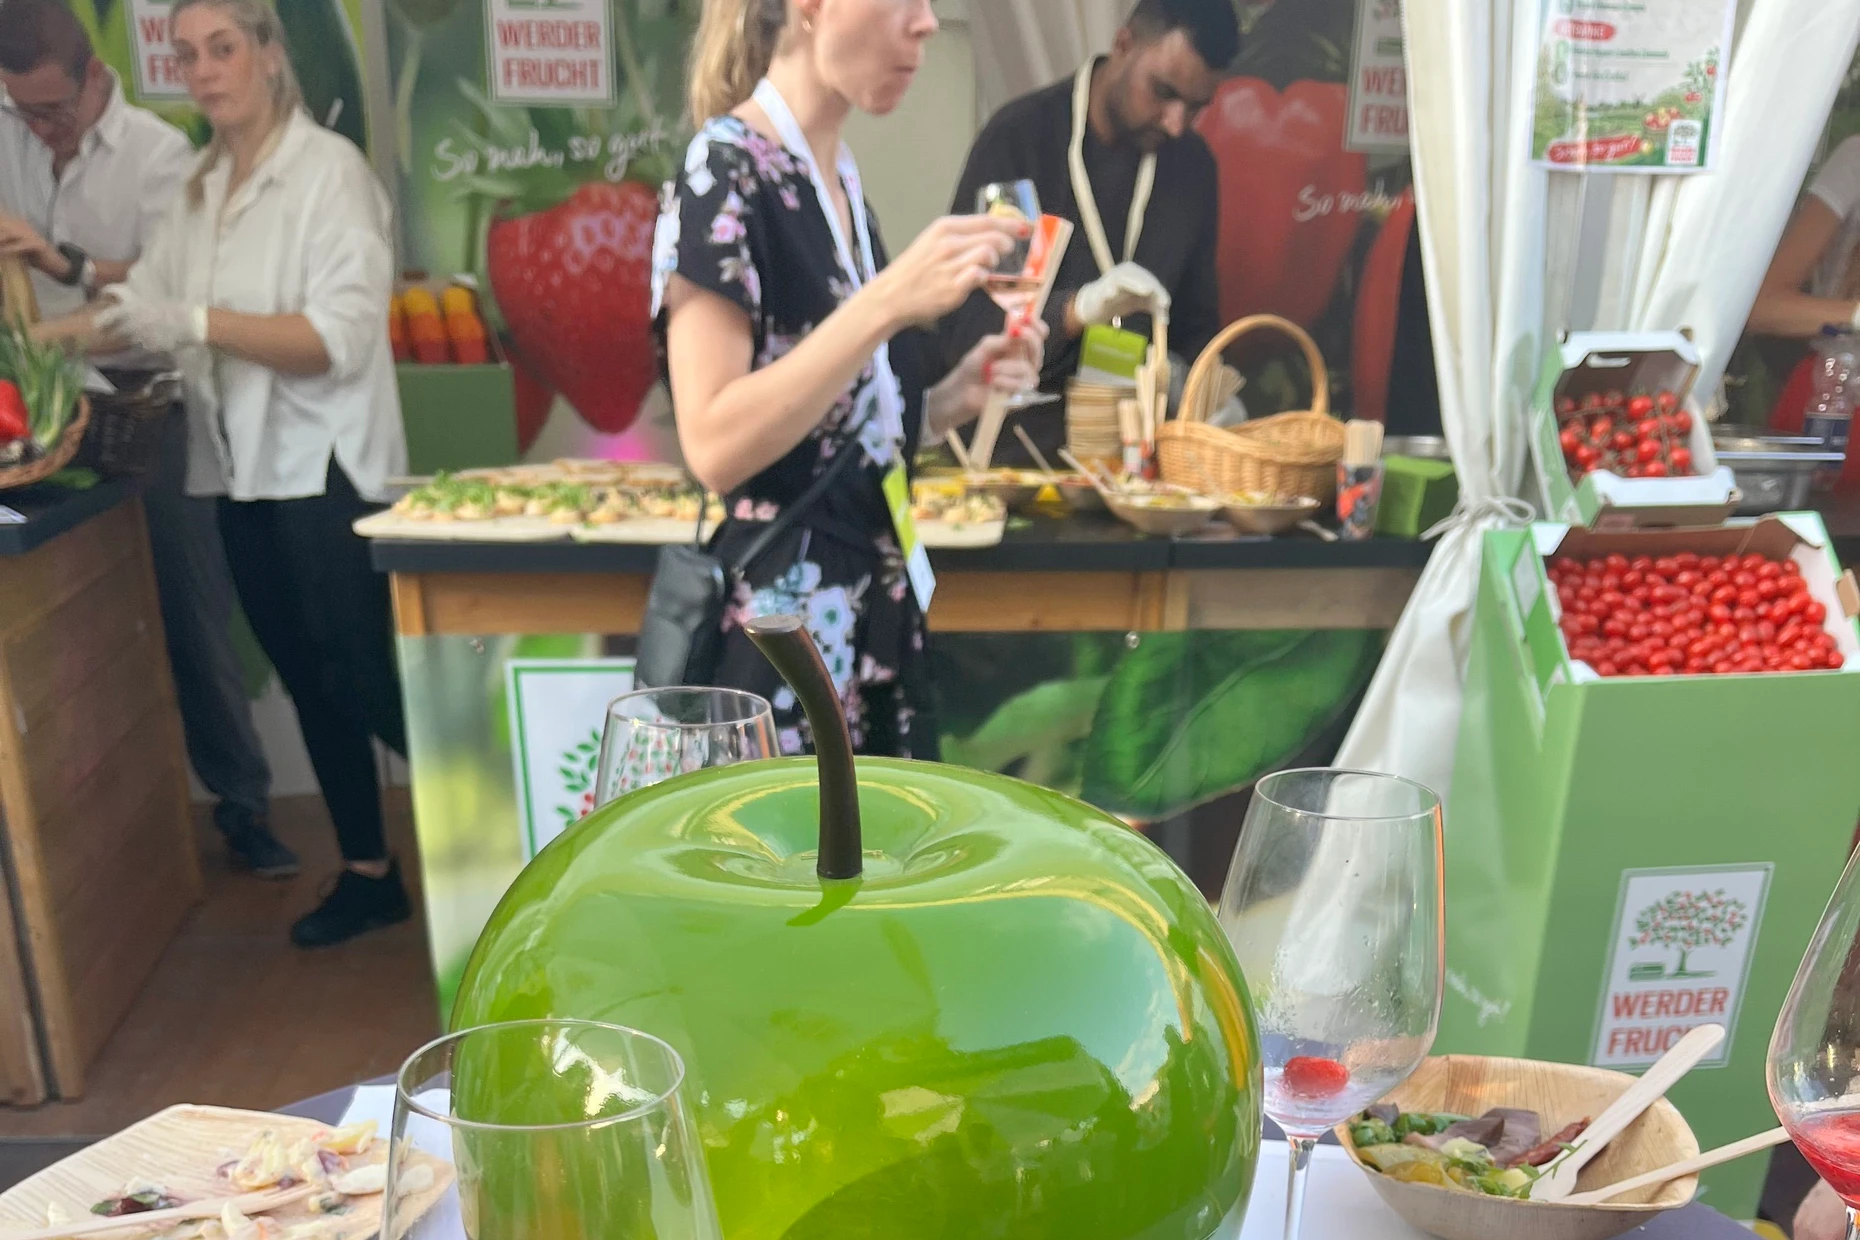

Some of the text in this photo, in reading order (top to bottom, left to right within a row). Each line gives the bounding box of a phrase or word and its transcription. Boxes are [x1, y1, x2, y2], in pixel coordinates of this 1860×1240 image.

[496, 19, 602, 49] WERDER
[502, 58, 602, 89] FRUCHT
[430, 137, 479, 182] So
[1612, 986, 1730, 1020] WERDER
[1606, 1025, 1692, 1057] FRUC
